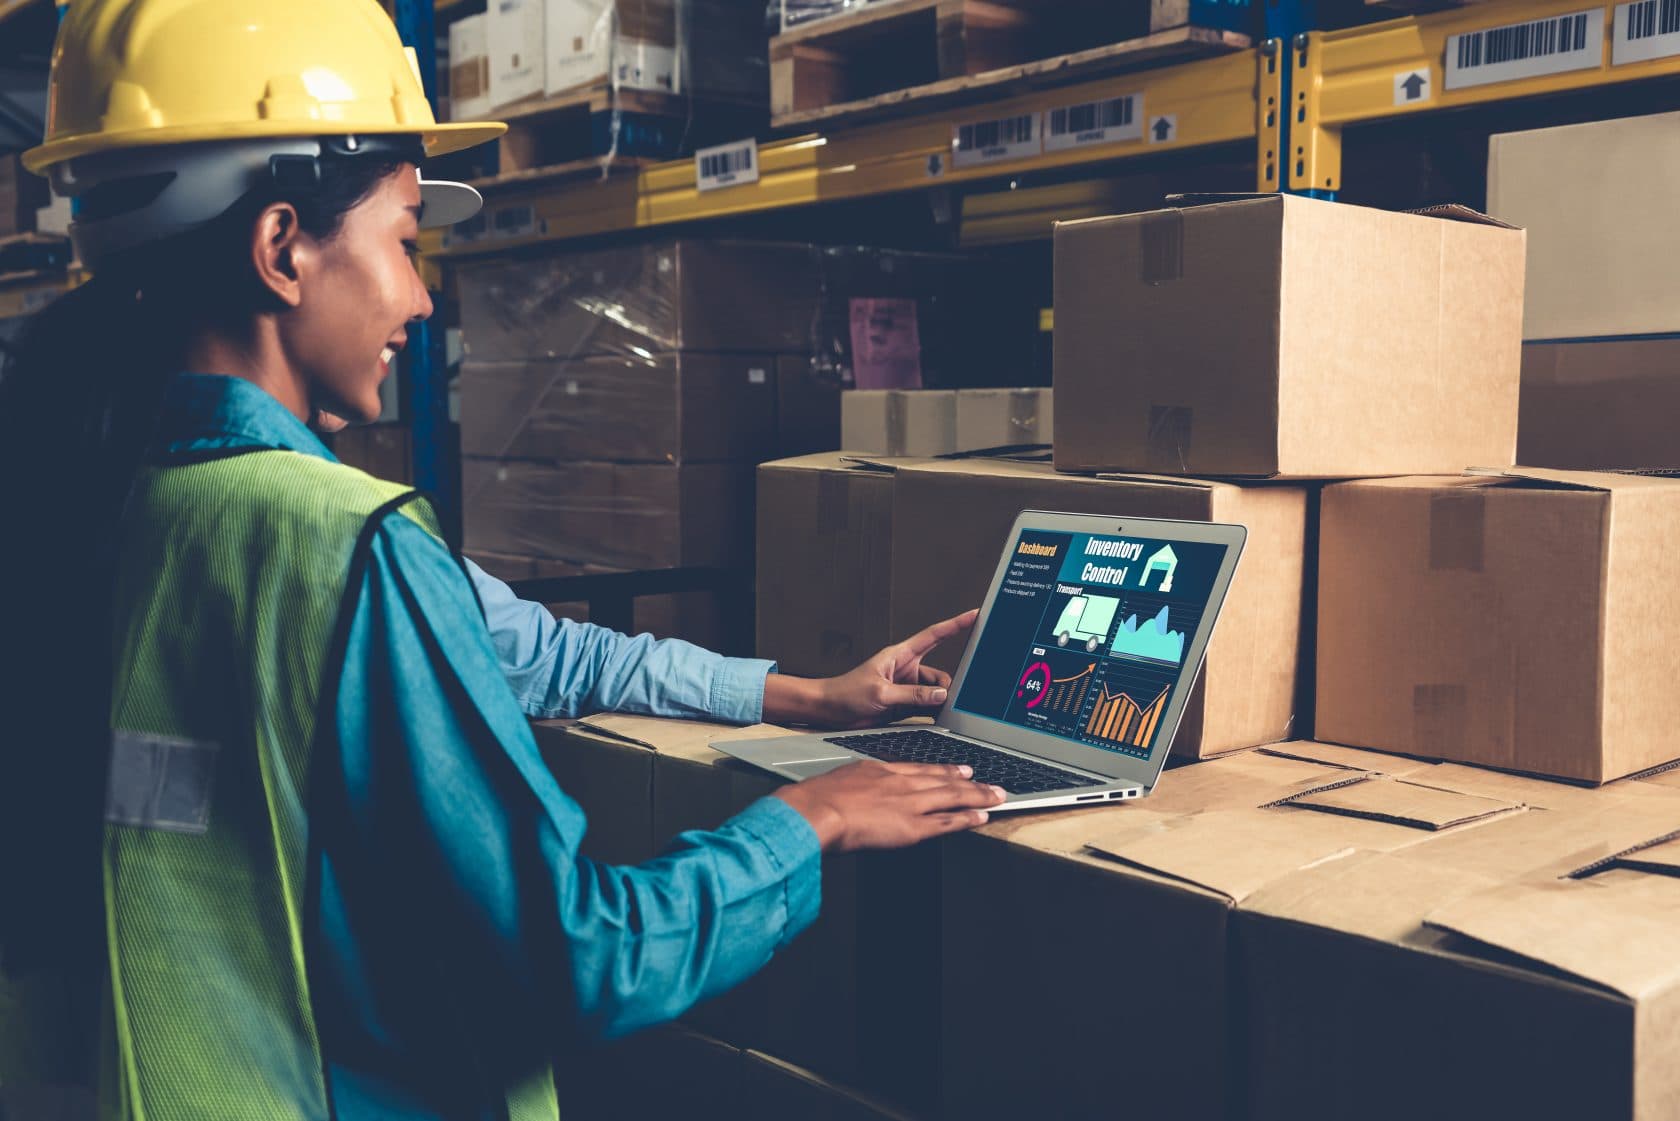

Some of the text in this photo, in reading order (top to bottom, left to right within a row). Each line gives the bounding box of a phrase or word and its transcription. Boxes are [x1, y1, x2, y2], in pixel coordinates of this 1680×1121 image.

[1018, 542, 1058, 556] Dashboard
[1084, 537, 1144, 562] Inventory
[1081, 562, 1128, 585] Control
[1056, 584, 1083, 596] Transport
[1026, 679, 1041, 692] 64%
